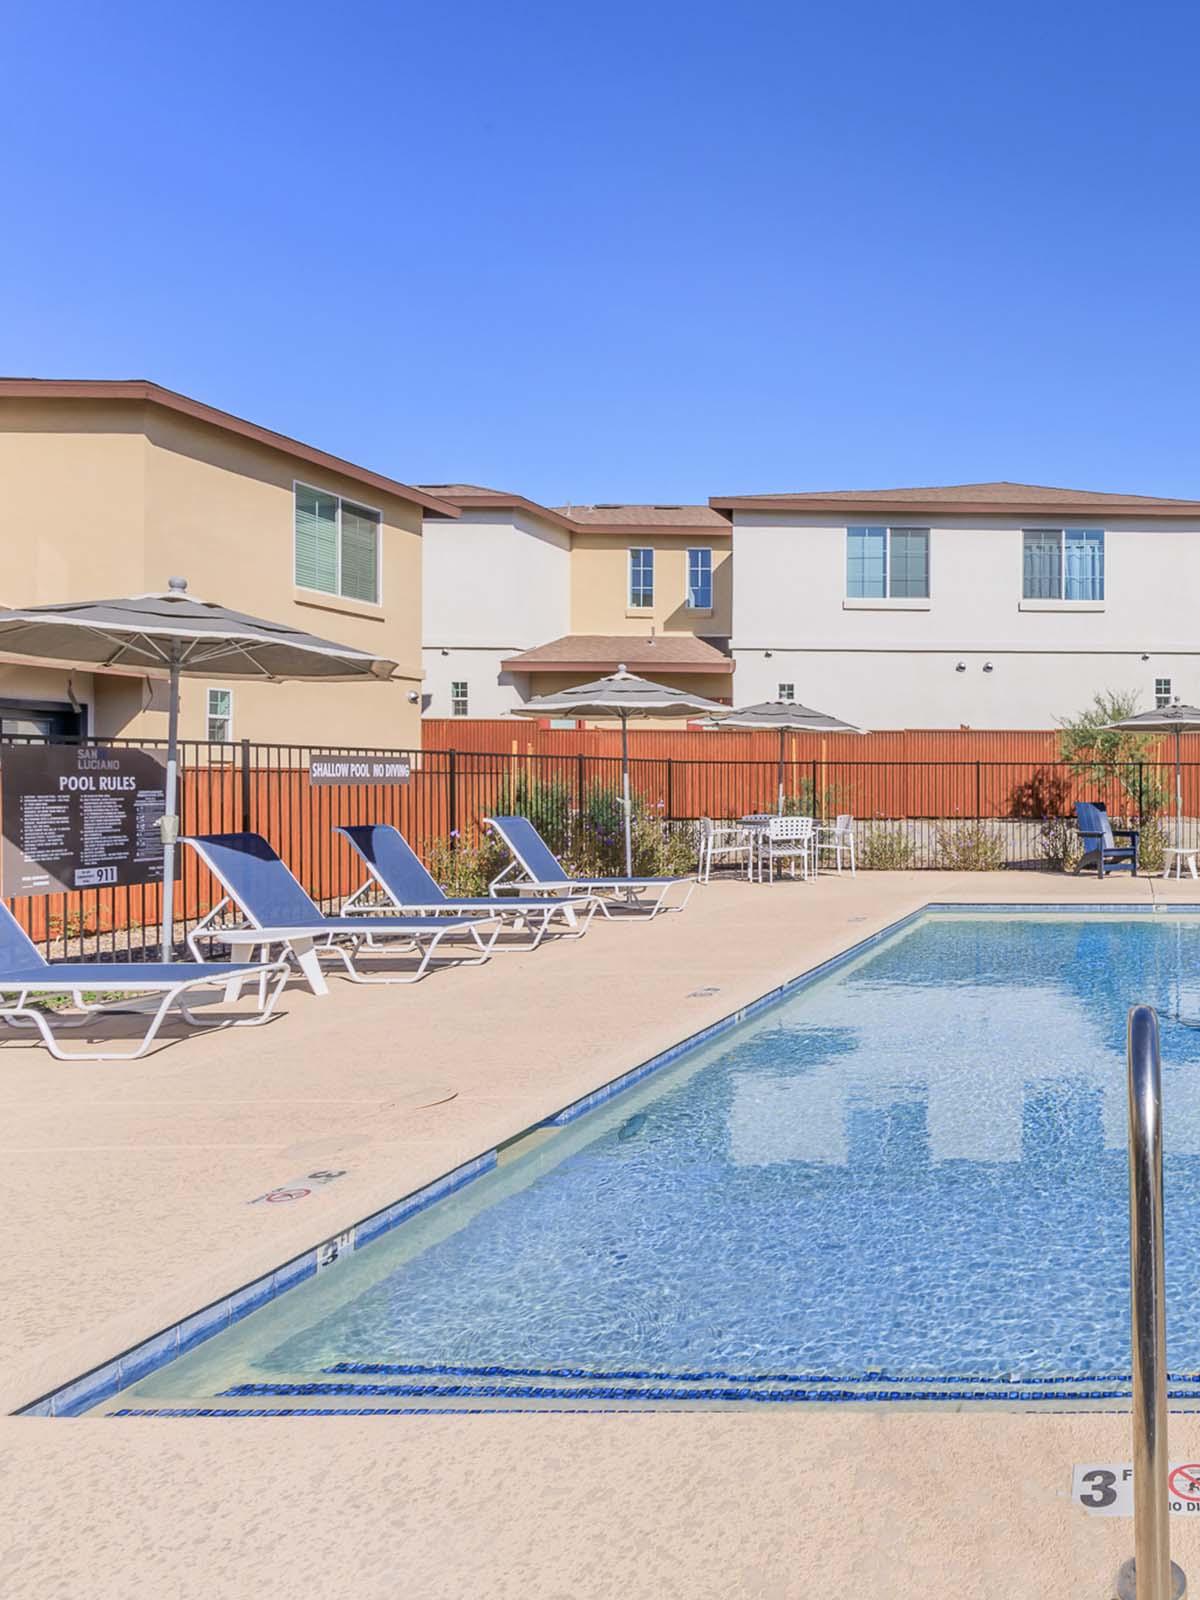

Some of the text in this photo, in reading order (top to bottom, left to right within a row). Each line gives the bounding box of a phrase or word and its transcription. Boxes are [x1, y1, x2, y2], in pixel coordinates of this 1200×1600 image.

[77, 748, 98, 759] SAN
[77, 760, 120, 770] LUCIANO
[312, 762, 410, 777] SHALLOW POOL NO DIVING
[59, 776, 136, 791] POOL RULES
[97, 868, 114, 882] 911
[1079, 1469, 1133, 1508] 3 F
[1168, 1502, 1182, 1512] O
